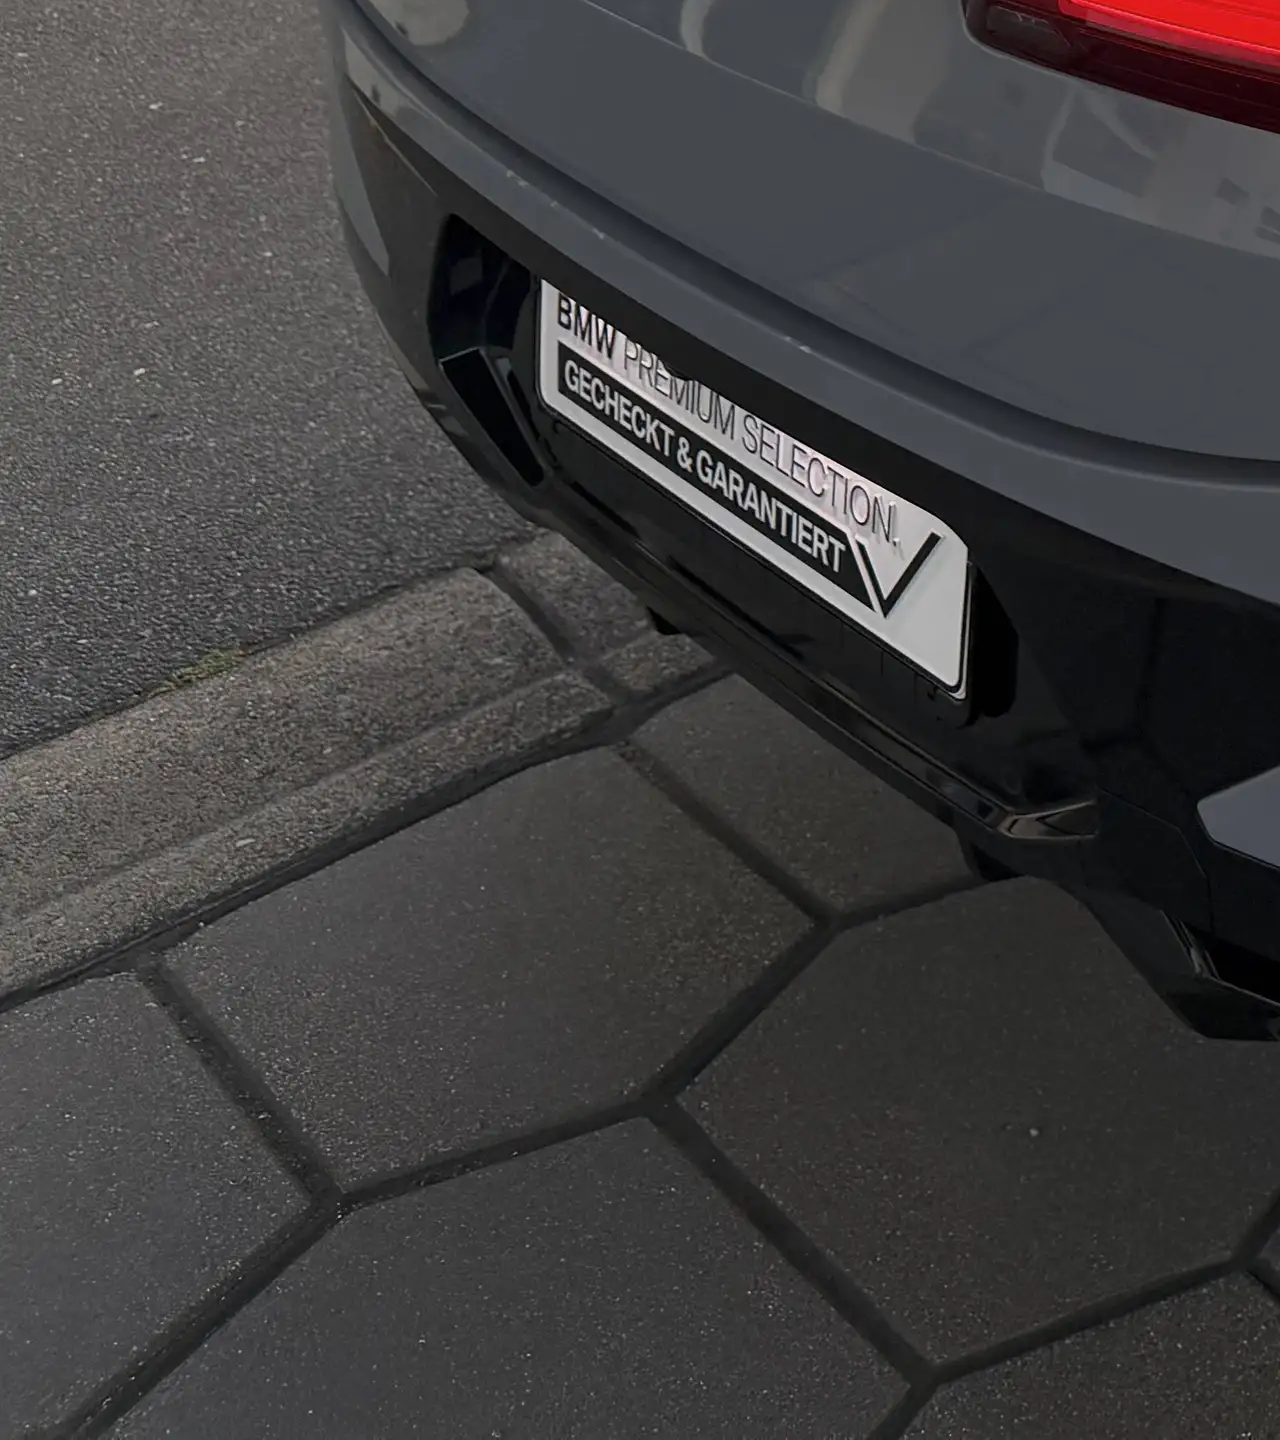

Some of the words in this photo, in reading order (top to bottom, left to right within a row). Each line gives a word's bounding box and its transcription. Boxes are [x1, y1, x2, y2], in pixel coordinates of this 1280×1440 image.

[556, 292, 616, 360] BMW
[623, 334, 735, 442] PREMIUM
[564, 359, 676, 458] GECHECKT
[676, 435, 695, 473] &
[695, 447, 846, 573] GARANTIERT
